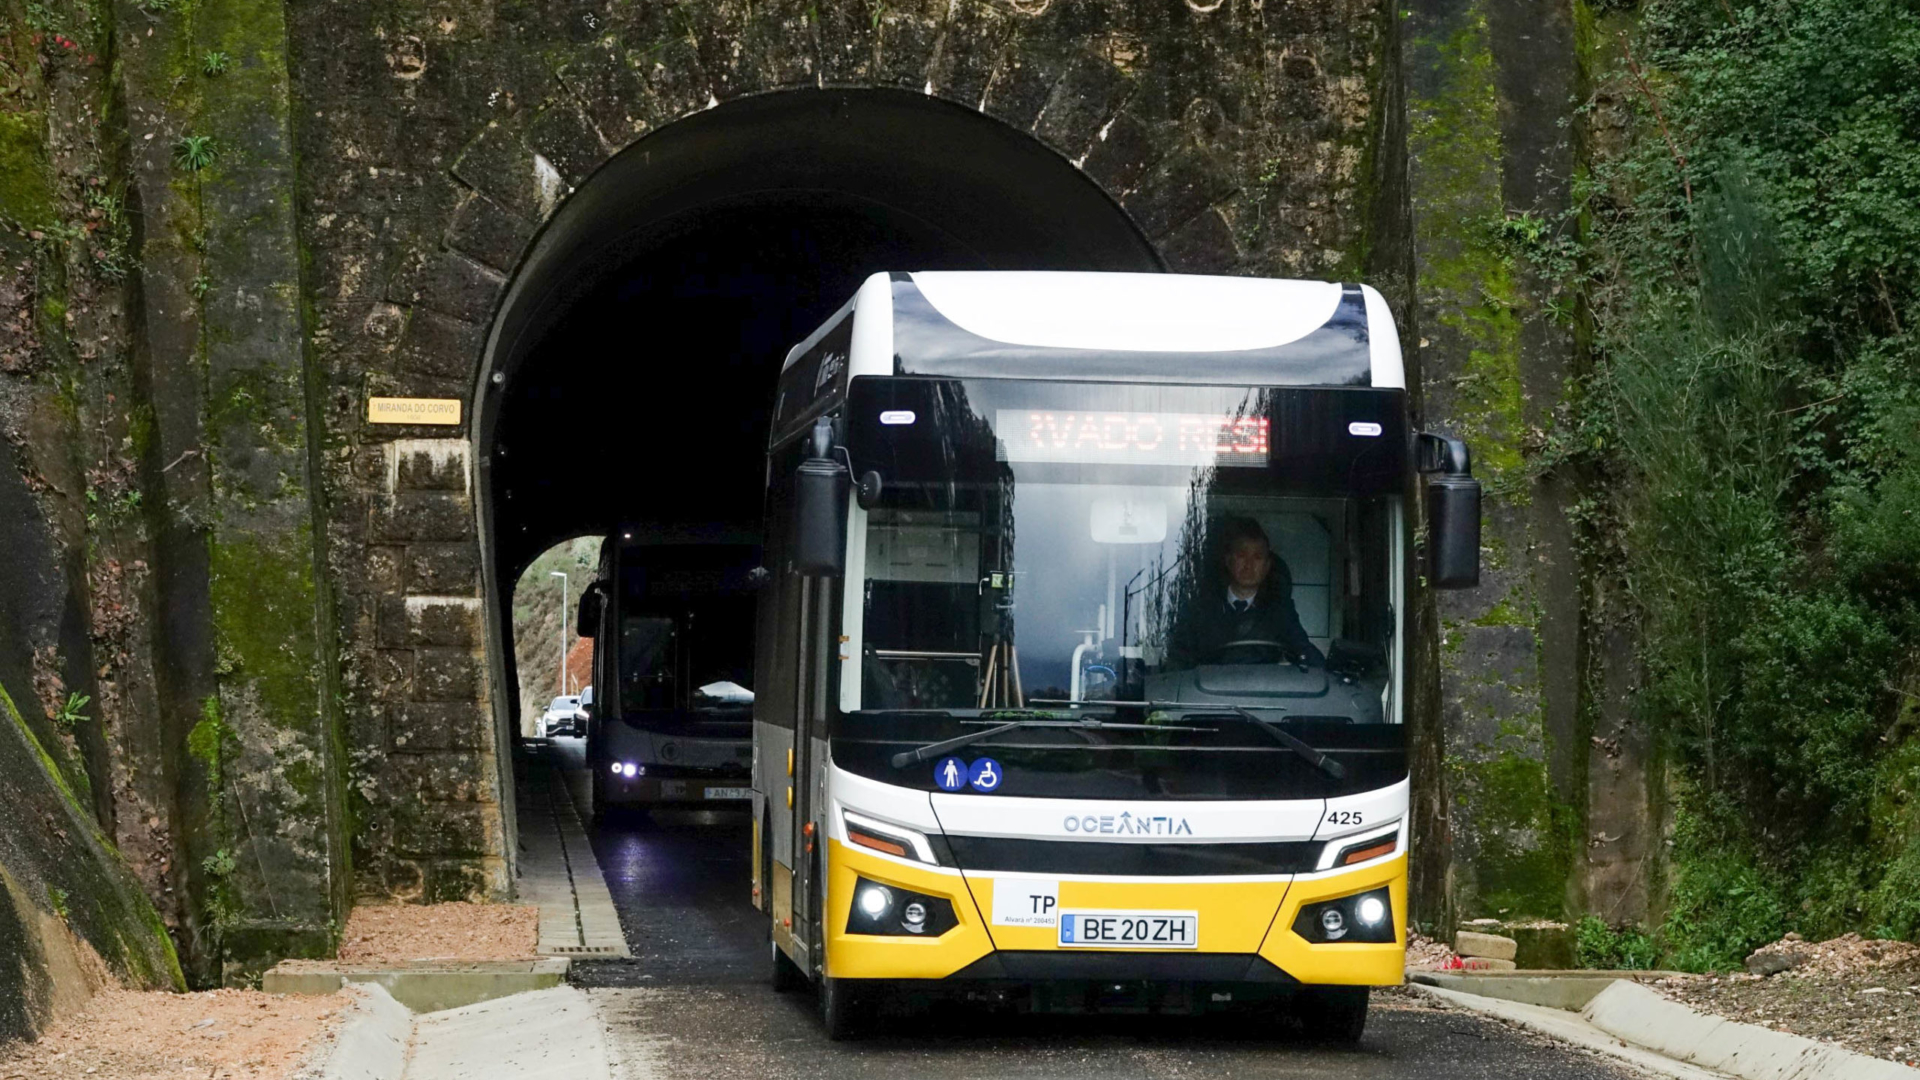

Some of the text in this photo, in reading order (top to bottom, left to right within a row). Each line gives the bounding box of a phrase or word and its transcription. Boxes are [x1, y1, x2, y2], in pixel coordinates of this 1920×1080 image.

[377, 402, 455, 414] MIRANDA DO CORVO
[1063, 811, 1193, 835] OCEÂNTIA
[1327, 811, 1363, 825] 425
[1029, 895, 1056, 914] TP
